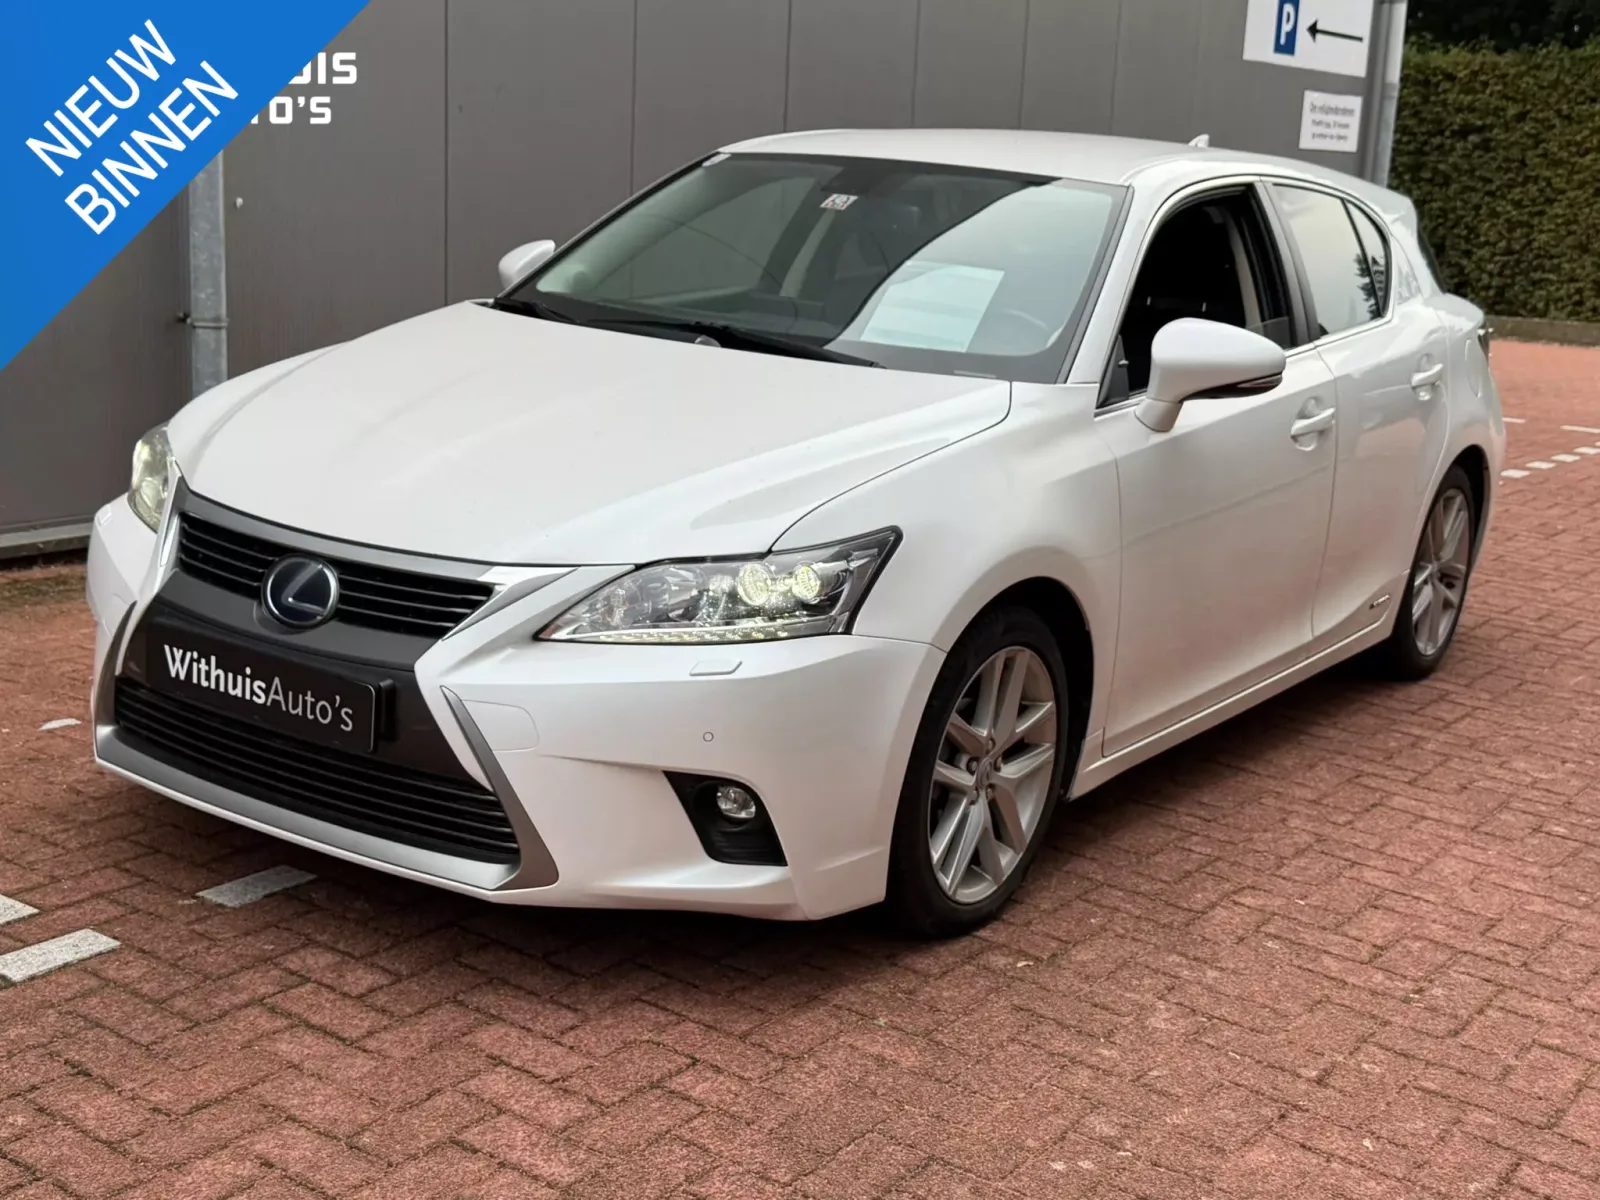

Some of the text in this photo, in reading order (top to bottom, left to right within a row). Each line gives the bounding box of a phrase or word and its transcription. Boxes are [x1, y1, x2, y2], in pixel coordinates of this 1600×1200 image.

[1280, 3, 1295, 46] P
[251, 95, 332, 125] O'S
[163, 644, 354, 732] WithuisAuto's
